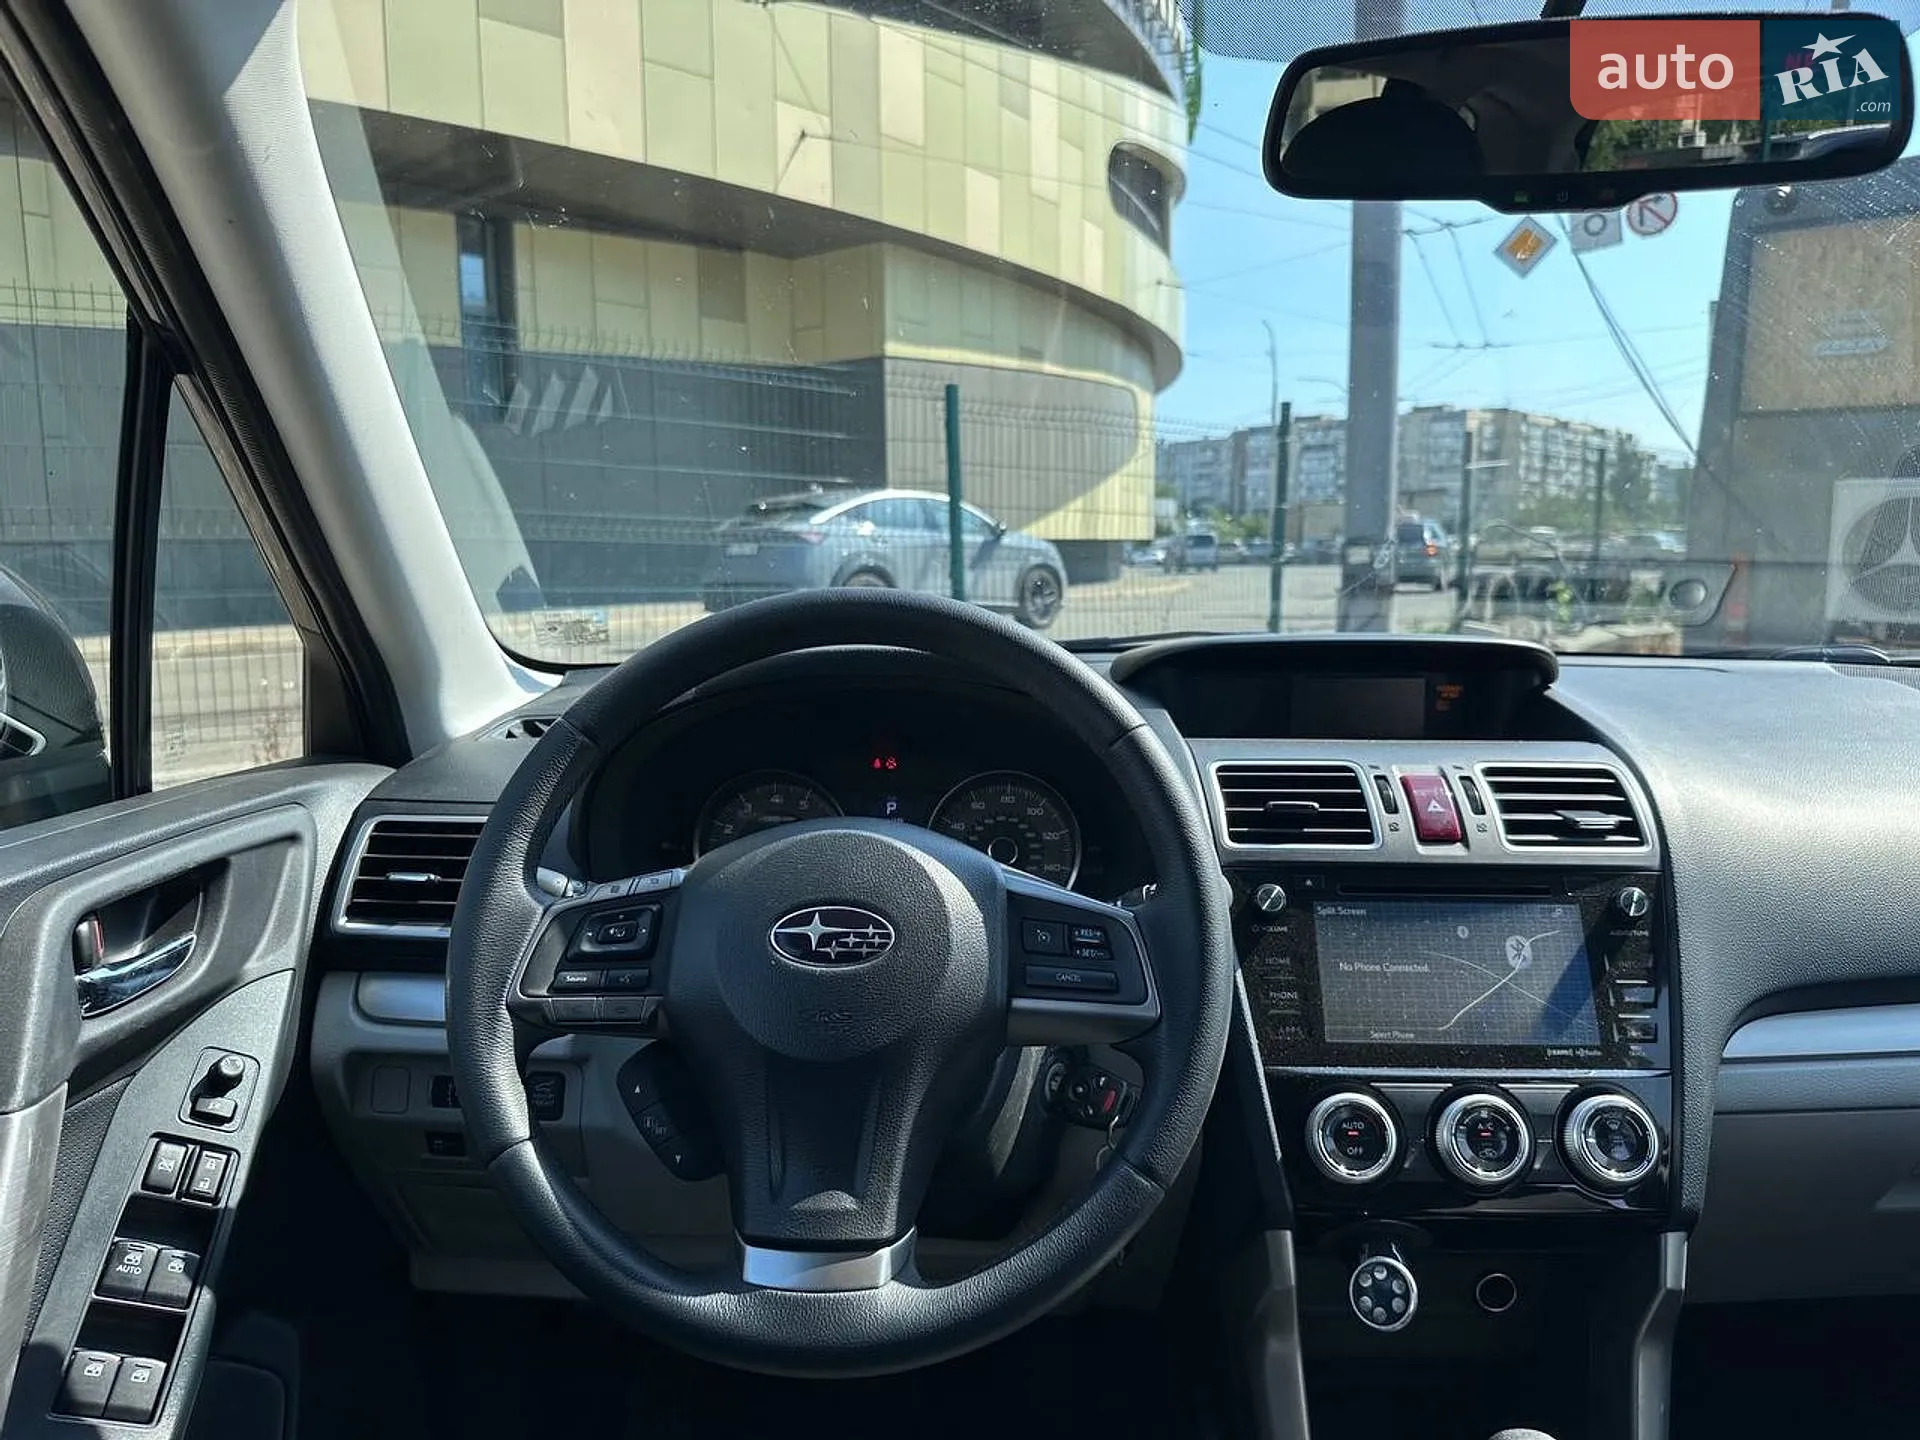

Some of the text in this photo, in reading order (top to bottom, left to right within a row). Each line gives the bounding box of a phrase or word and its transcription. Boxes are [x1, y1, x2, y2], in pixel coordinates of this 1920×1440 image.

[886, 802, 897, 816] P
[1026, 807, 1044, 816] 100
[1339, 962, 1353, 971] No
[1354, 962, 1380, 972] Phone
[1341, 1121, 1365, 1130] AUTO
[115, 1264, 142, 1275] AUTO
